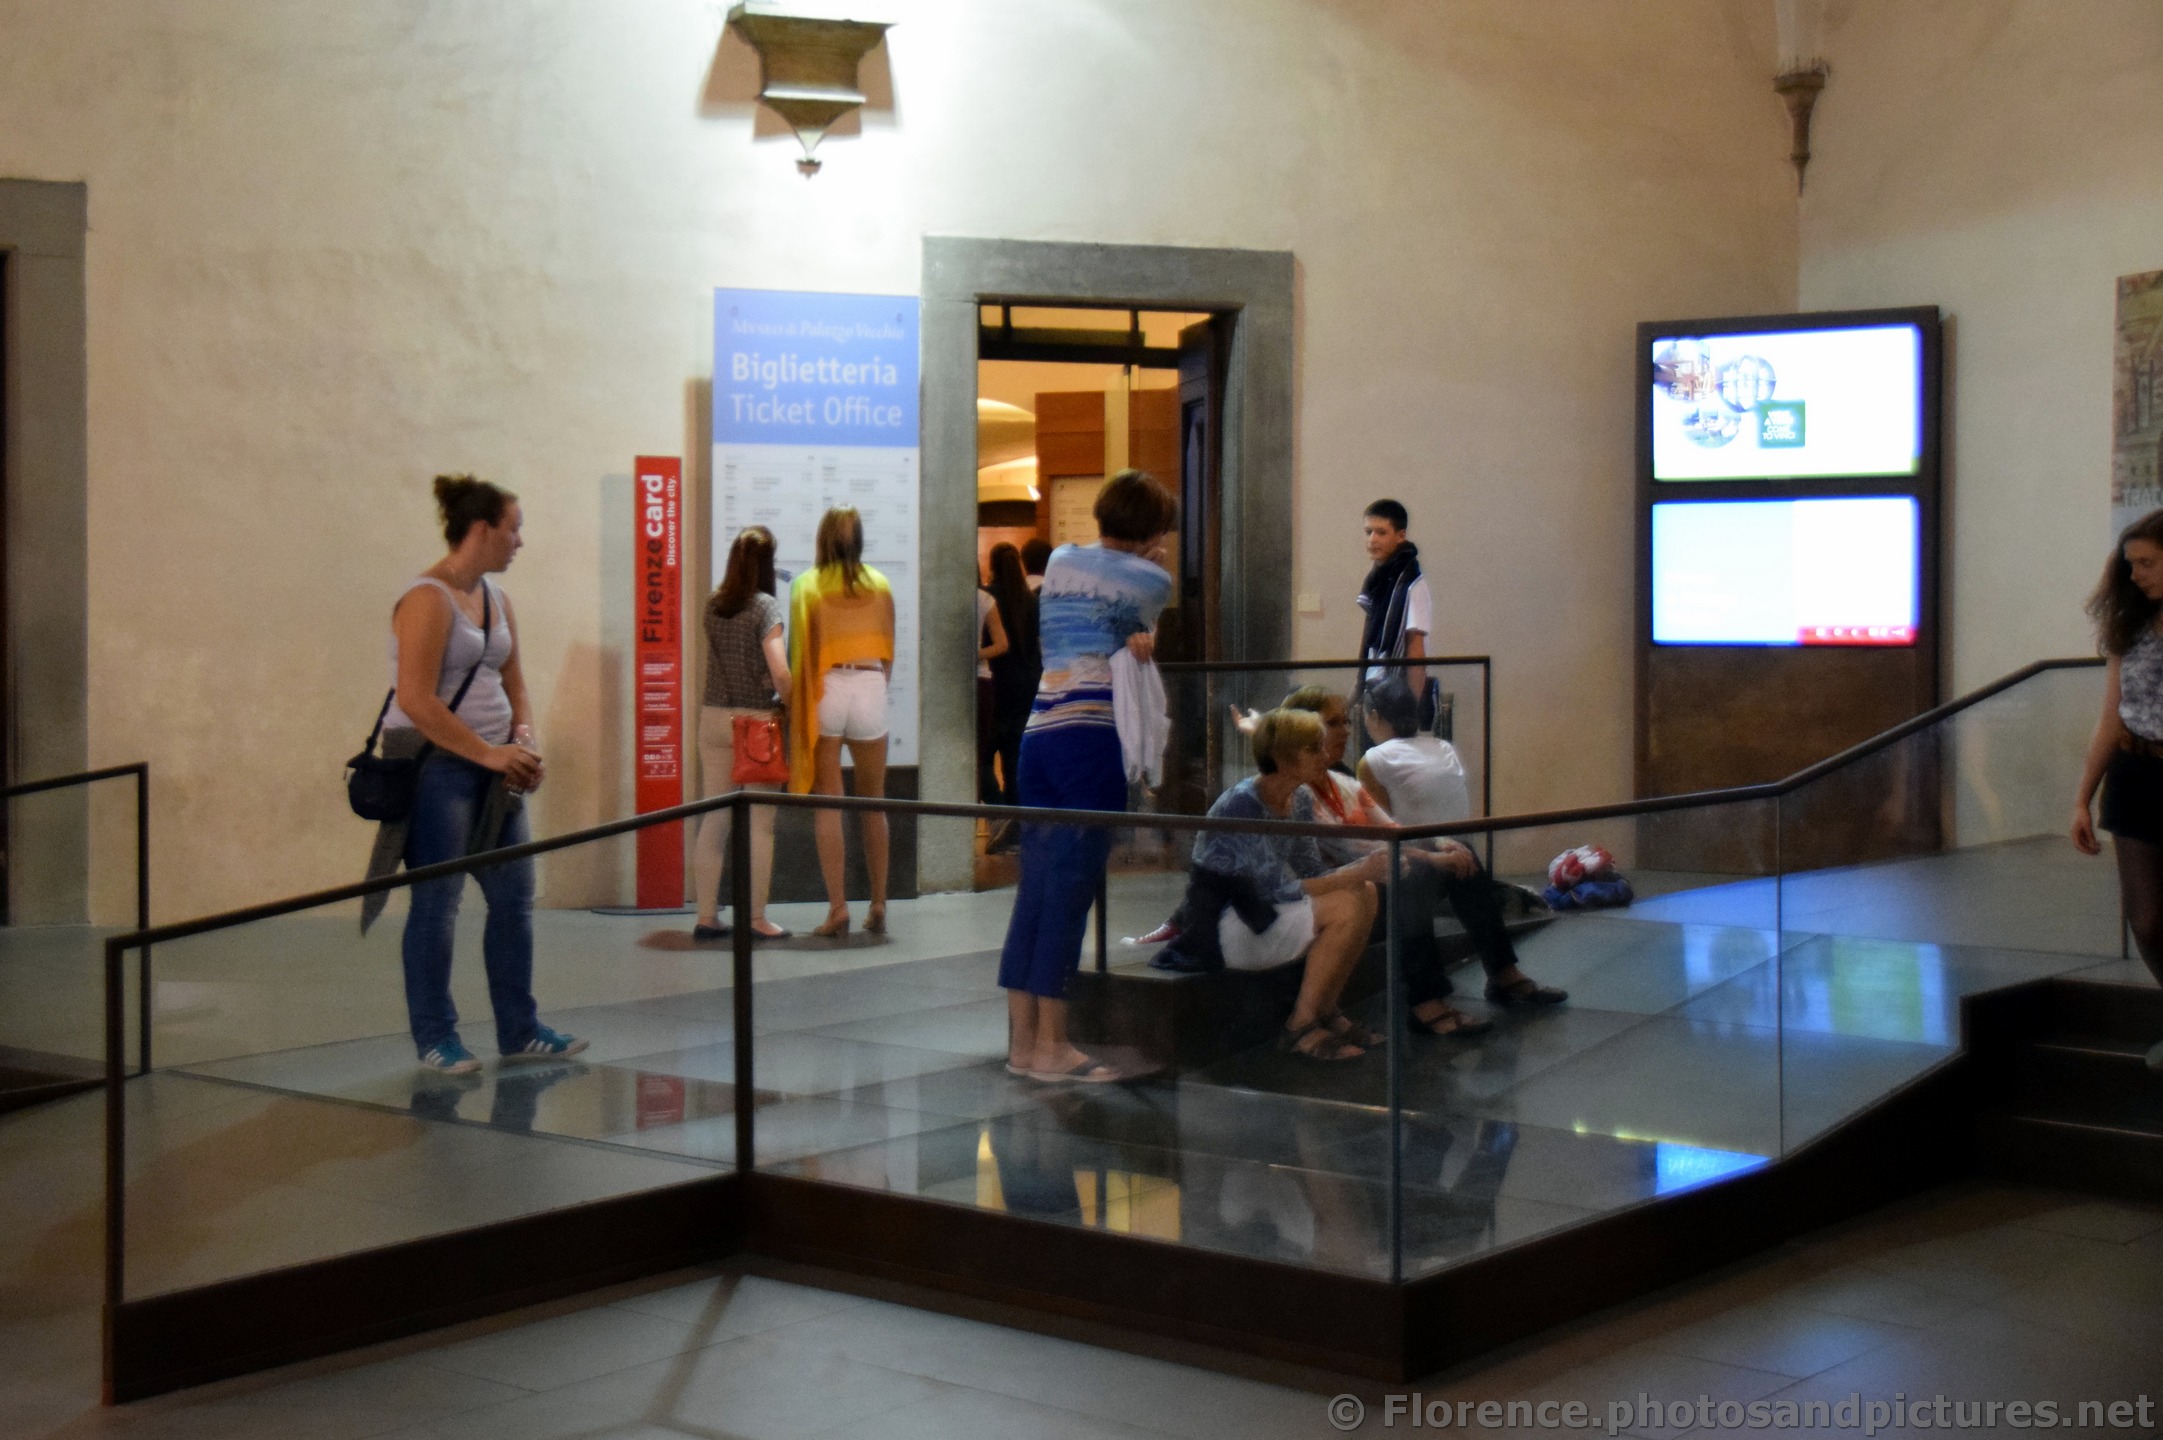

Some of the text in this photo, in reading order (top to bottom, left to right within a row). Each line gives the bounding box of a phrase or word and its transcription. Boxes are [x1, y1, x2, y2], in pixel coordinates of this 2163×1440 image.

[732, 352, 898, 390] Biglietteria
[731, 393, 902, 426] Ticket Office
[667, 475, 677, 498] city.
[667, 500, 676, 518] the
[667, 520, 676, 566] Discover
